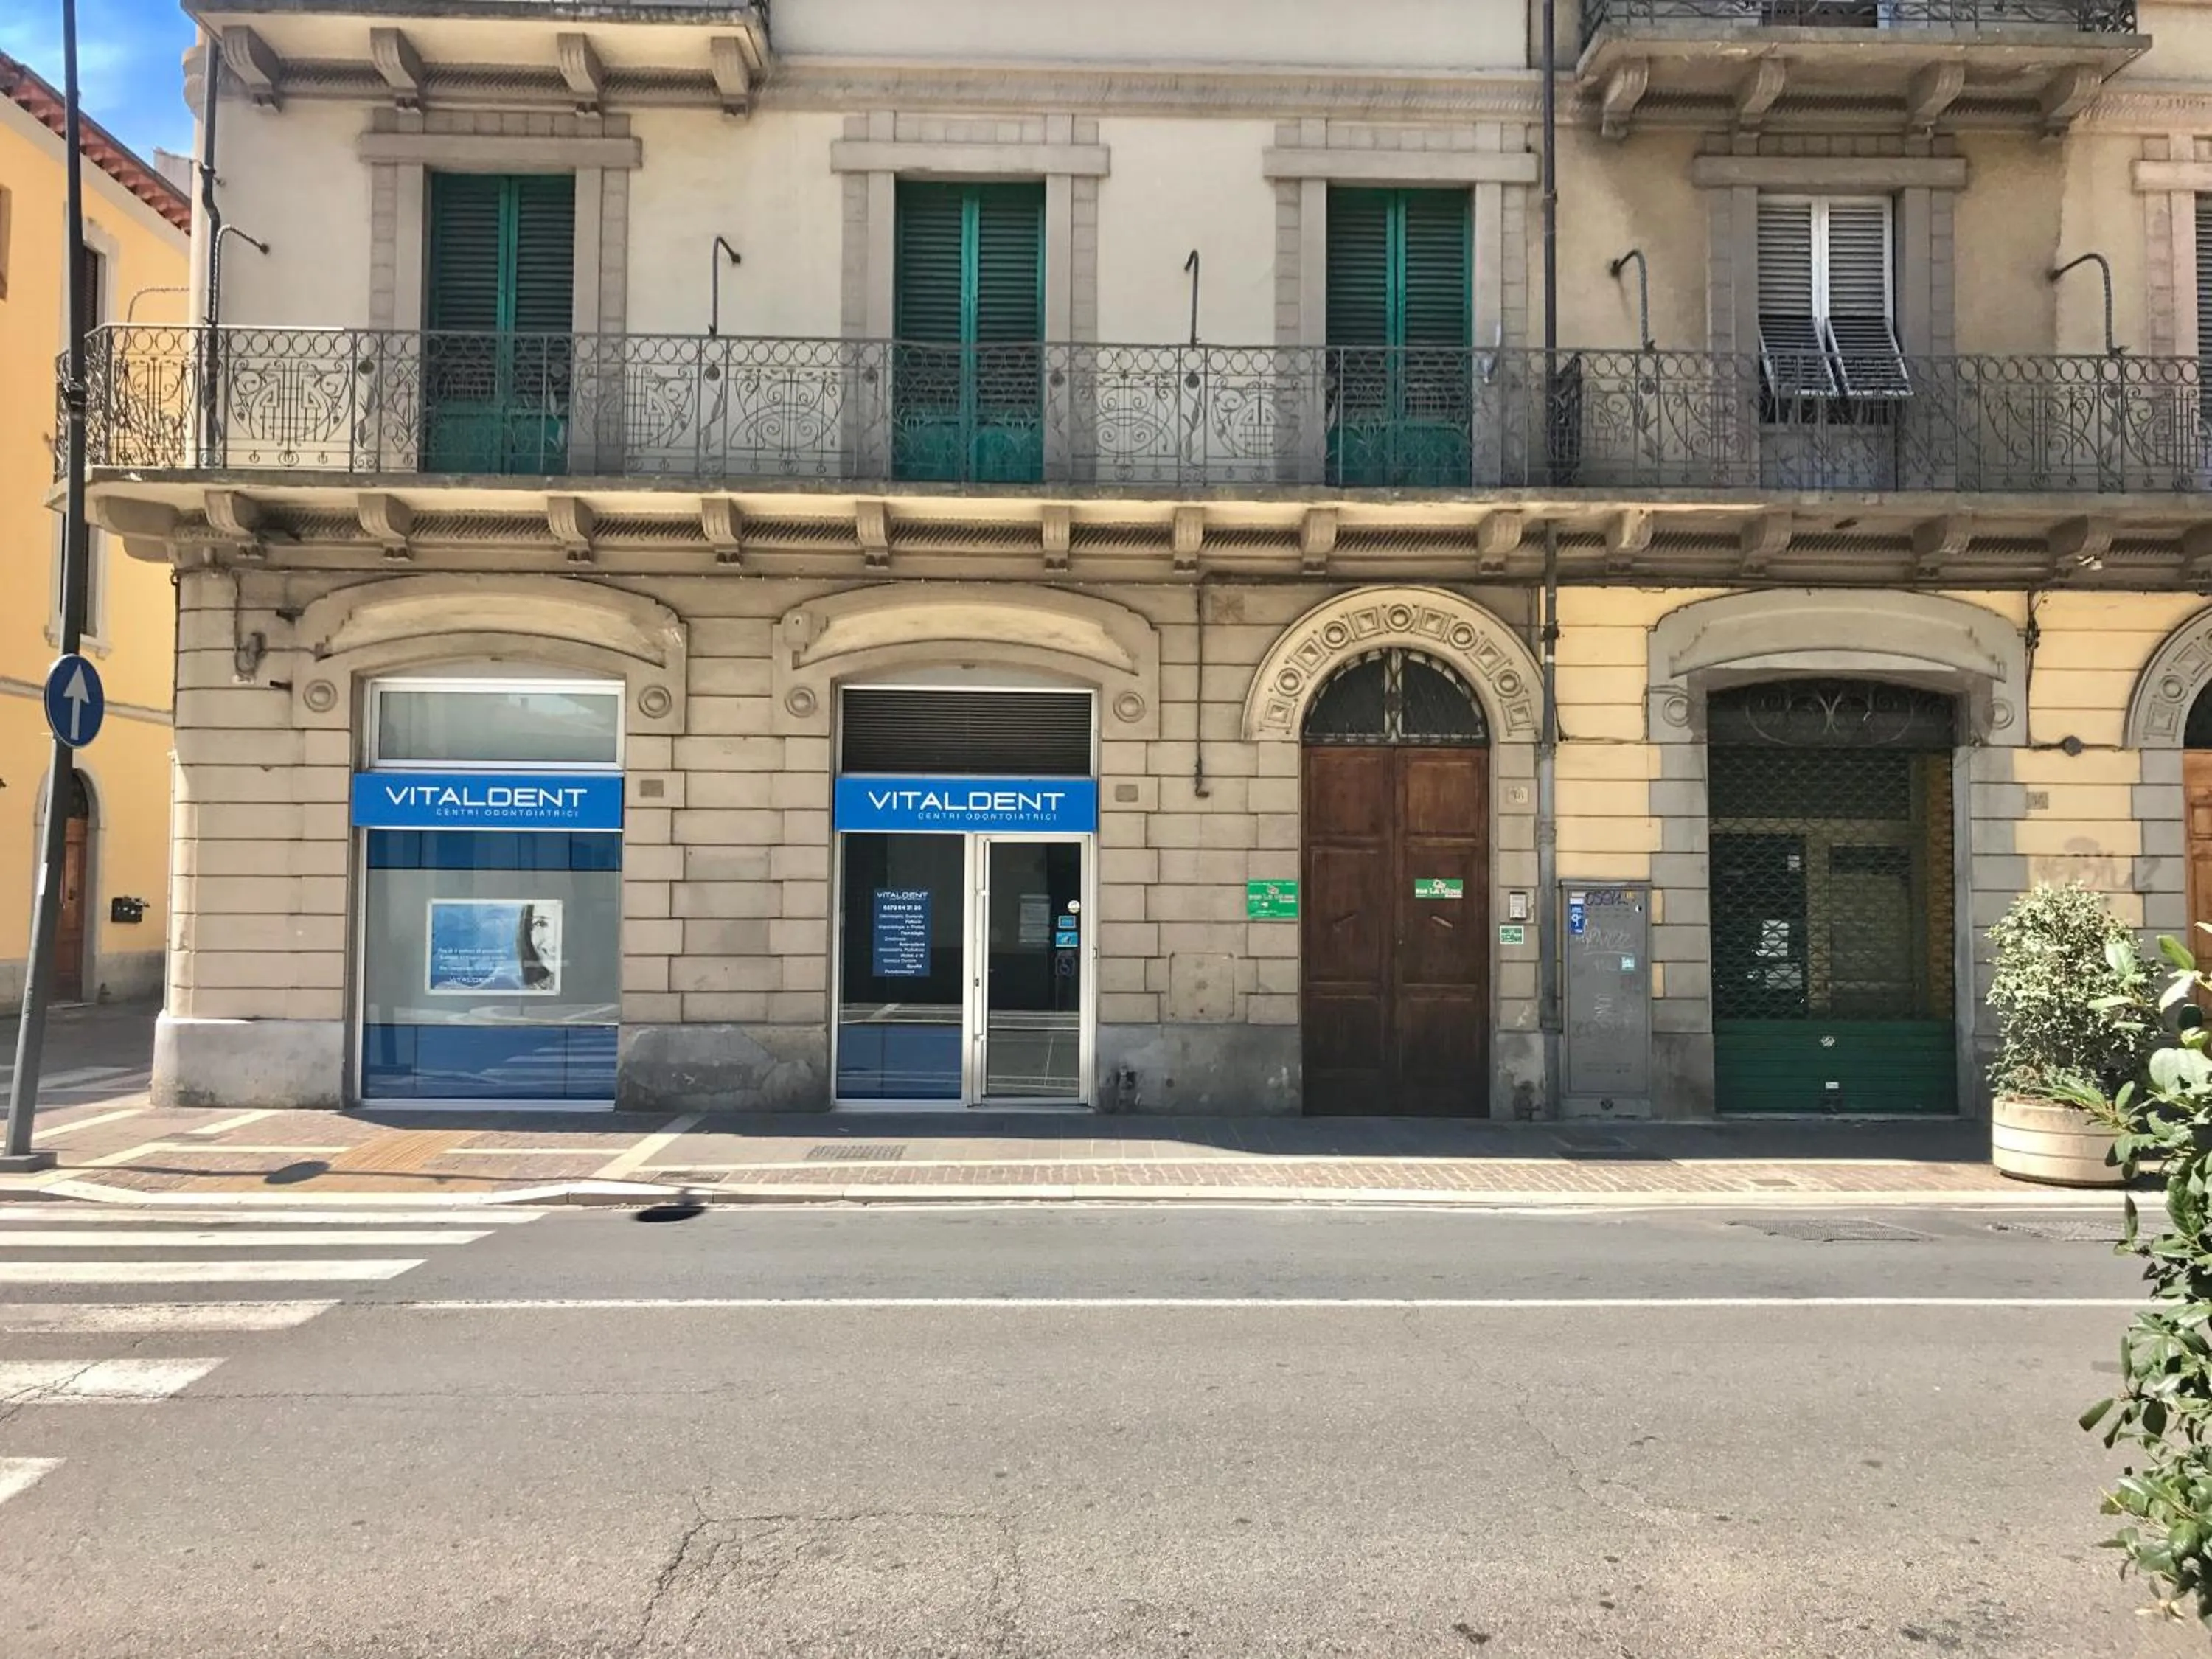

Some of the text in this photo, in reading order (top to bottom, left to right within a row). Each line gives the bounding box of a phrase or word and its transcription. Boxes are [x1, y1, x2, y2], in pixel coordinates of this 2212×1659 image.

[385, 786, 588, 807] VITALDENT
[868, 791, 1065, 810] VITALDENT
[436, 808, 579, 818] CENTRI ODONTOIATRICI
[966, 813, 1057, 821] ODONTOIATRICI
